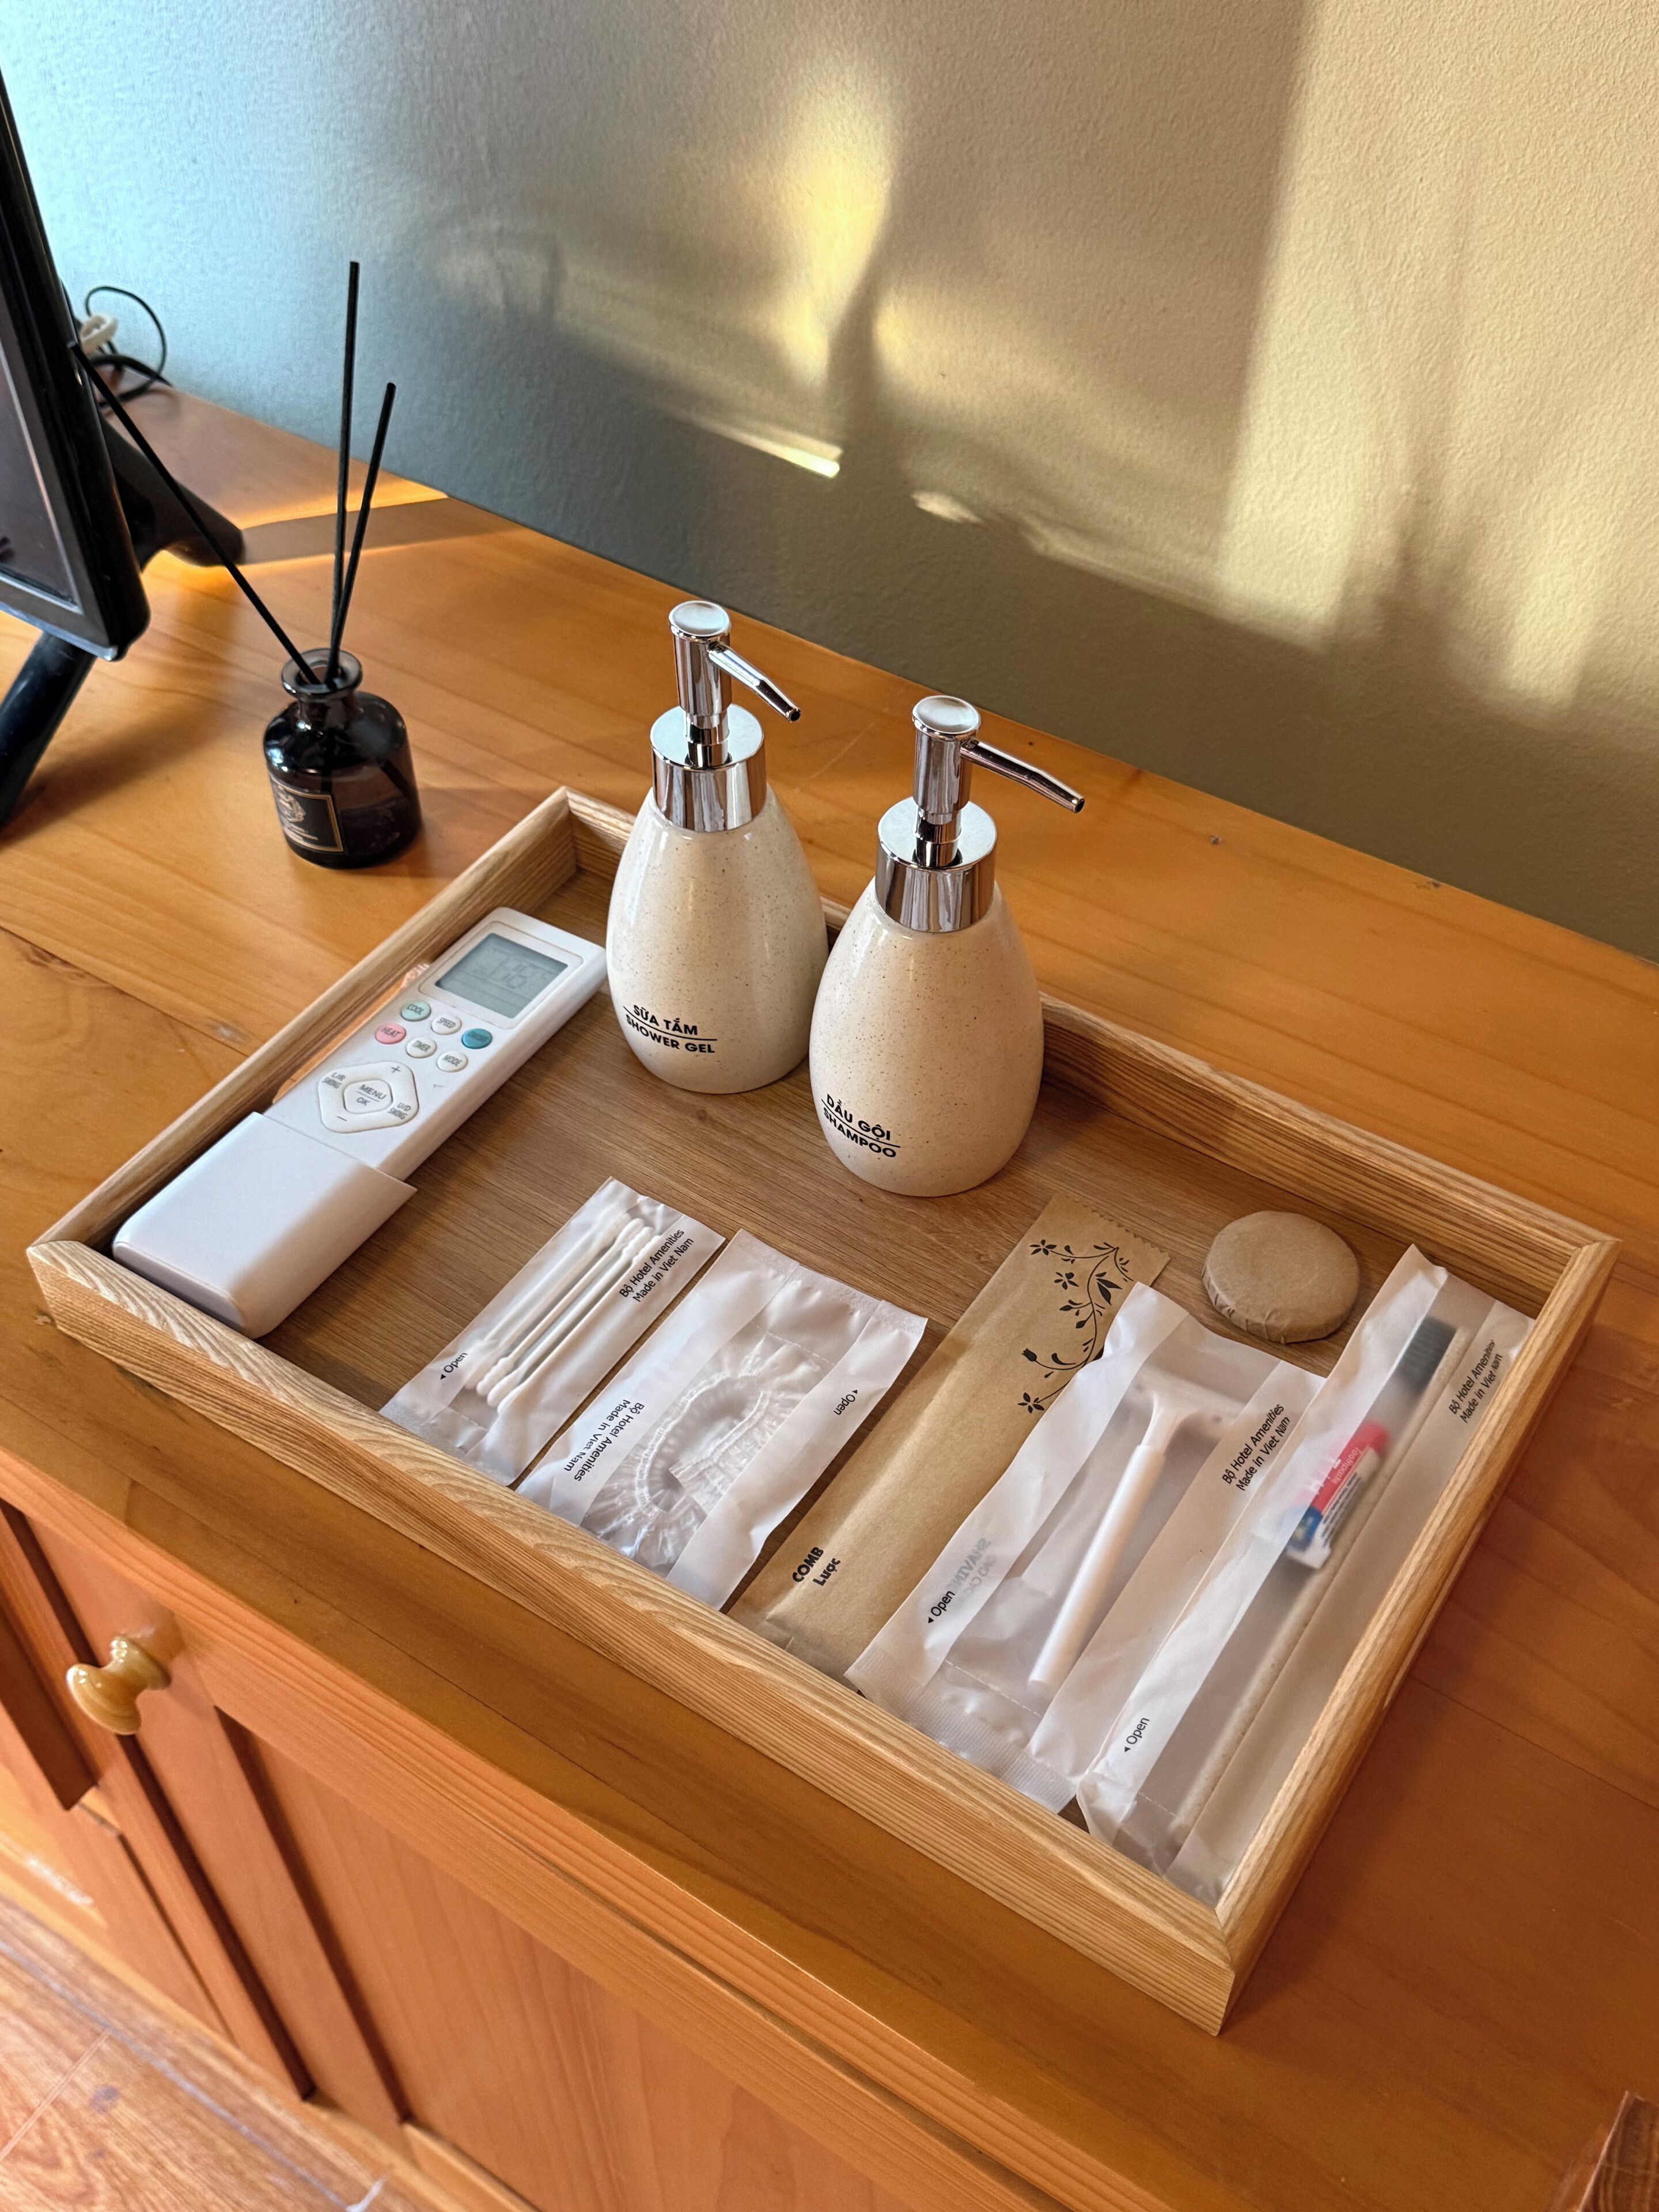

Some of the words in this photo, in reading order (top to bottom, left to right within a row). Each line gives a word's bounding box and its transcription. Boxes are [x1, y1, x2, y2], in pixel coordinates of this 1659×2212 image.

[407, 1003, 425, 1016] COOL
[381, 1027, 403, 1038] HEAT
[436, 1017, 456, 1029] SPEED
[626, 1014, 680, 1050] SHOWER
[684, 1043, 716, 1054] GEL
[663, 1017, 698, 1036] TẮM
[443, 1054, 463, 1067] MODE
[357, 1096, 371, 1107] OK
[359, 1084, 387, 1100] MENU
[827, 1093, 853, 1123] DẦU
[858, 1120, 891, 1141] GỘI
[823, 1107, 897, 1158] SHAMPOO
[619, 1283, 635, 1298] Bộ
[629, 1262, 653, 1286] Hotel
[649, 1229, 684, 1265] Amenities
[632, 1280, 656, 1302] Made
[652, 1271, 664, 1282] in
[659, 1255, 678, 1272] Viet
[674, 1238, 694, 1256] Nam
[444, 1353, 468, 1373] Open
[833, 1394, 856, 1415] Open
[1448, 1399, 1461, 1415] Bộ
[1456, 1376, 1475, 1402] Hotel
[1460, 1398, 1479, 1424] Made
[1474, 1388, 1485, 1400] in
[606, 1399, 631, 1422] Made
[628, 1402, 645, 1415] Bộ
[598, 1422, 611, 1431] in
[609, 1414, 634, 1437] Hotel
[584, 1433, 603, 1450] Viet
[1222, 1469, 1237, 1484] Bộ
[1230, 1442, 1253, 1471] Hotel
[1251, 1404, 1285, 1446] Amenities
[563, 1452, 586, 1471] Nam
[574, 1436, 612, 1482] Amenities
[1236, 1466, 1257, 1491] Made
[1252, 1456, 1265, 1467] in
[1260, 1435, 1279, 1456] Viet
[1275, 1416, 1290, 1437] Nam
[792, 1546, 824, 1583] COMB
[930, 1590, 956, 1617] Open
[1126, 1717, 1150, 1745] Open
